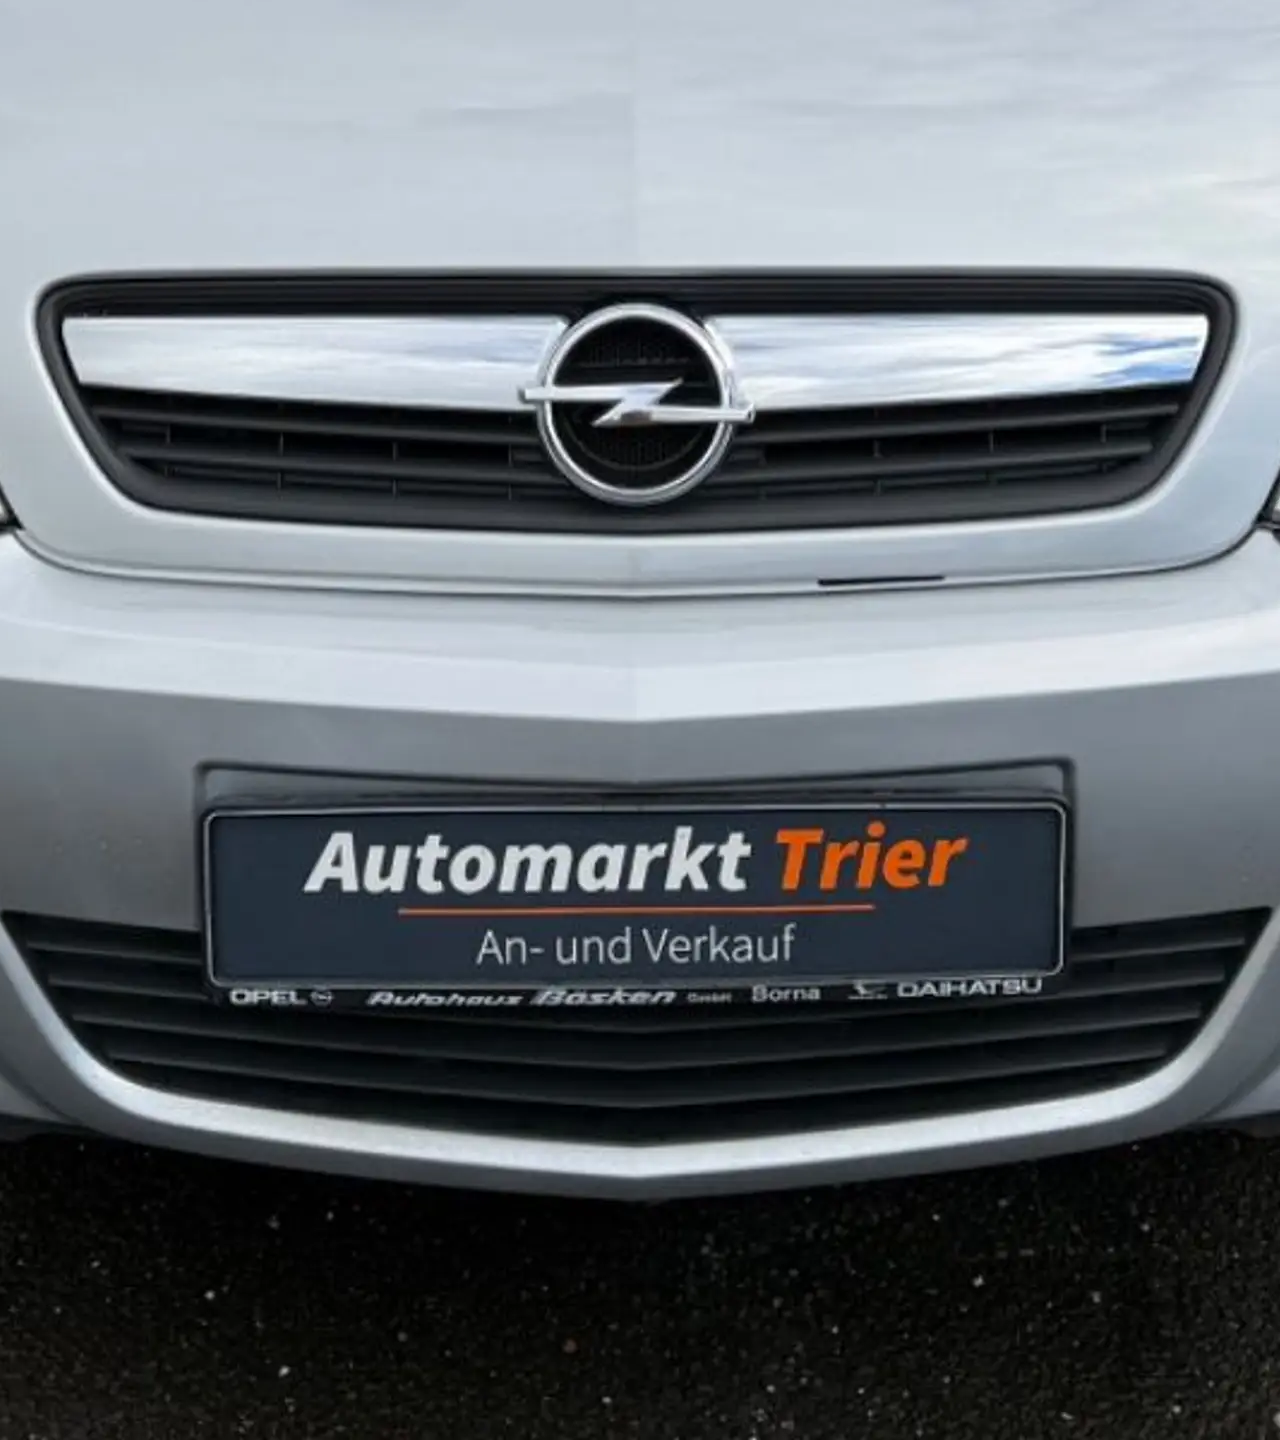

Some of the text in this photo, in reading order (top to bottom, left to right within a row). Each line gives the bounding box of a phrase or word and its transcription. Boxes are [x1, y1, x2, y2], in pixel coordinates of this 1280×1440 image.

[303, 820, 969, 895] Automarkt Trier
[475, 921, 798, 965] An- und Verkauf
[228, 988, 308, 1007] OPEL
[366, 990, 524, 1007] Autohaus
[751, 983, 821, 1003] Borna
[896, 976, 1043, 998] DAIHATSU
